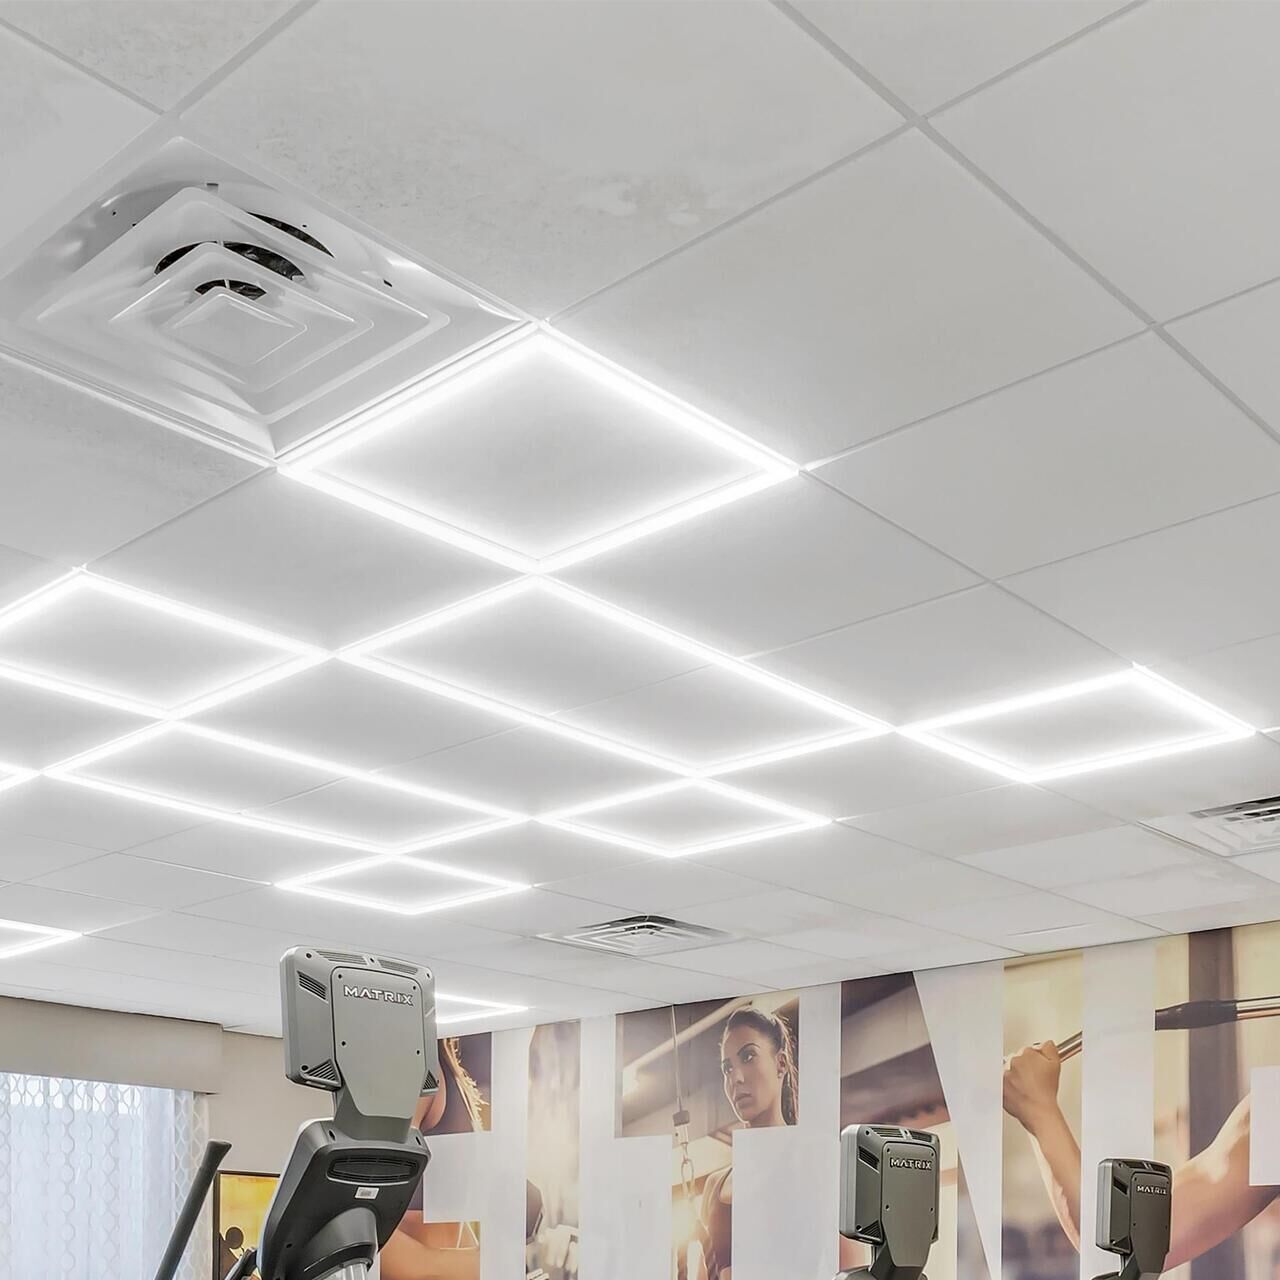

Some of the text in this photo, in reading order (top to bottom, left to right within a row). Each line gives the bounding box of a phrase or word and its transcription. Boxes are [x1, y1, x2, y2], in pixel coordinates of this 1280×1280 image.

[343, 984, 413, 1006] MATRIX
[889, 1156, 933, 1171] MATRIX
[1136, 1184, 1167, 1196] MATRIX
